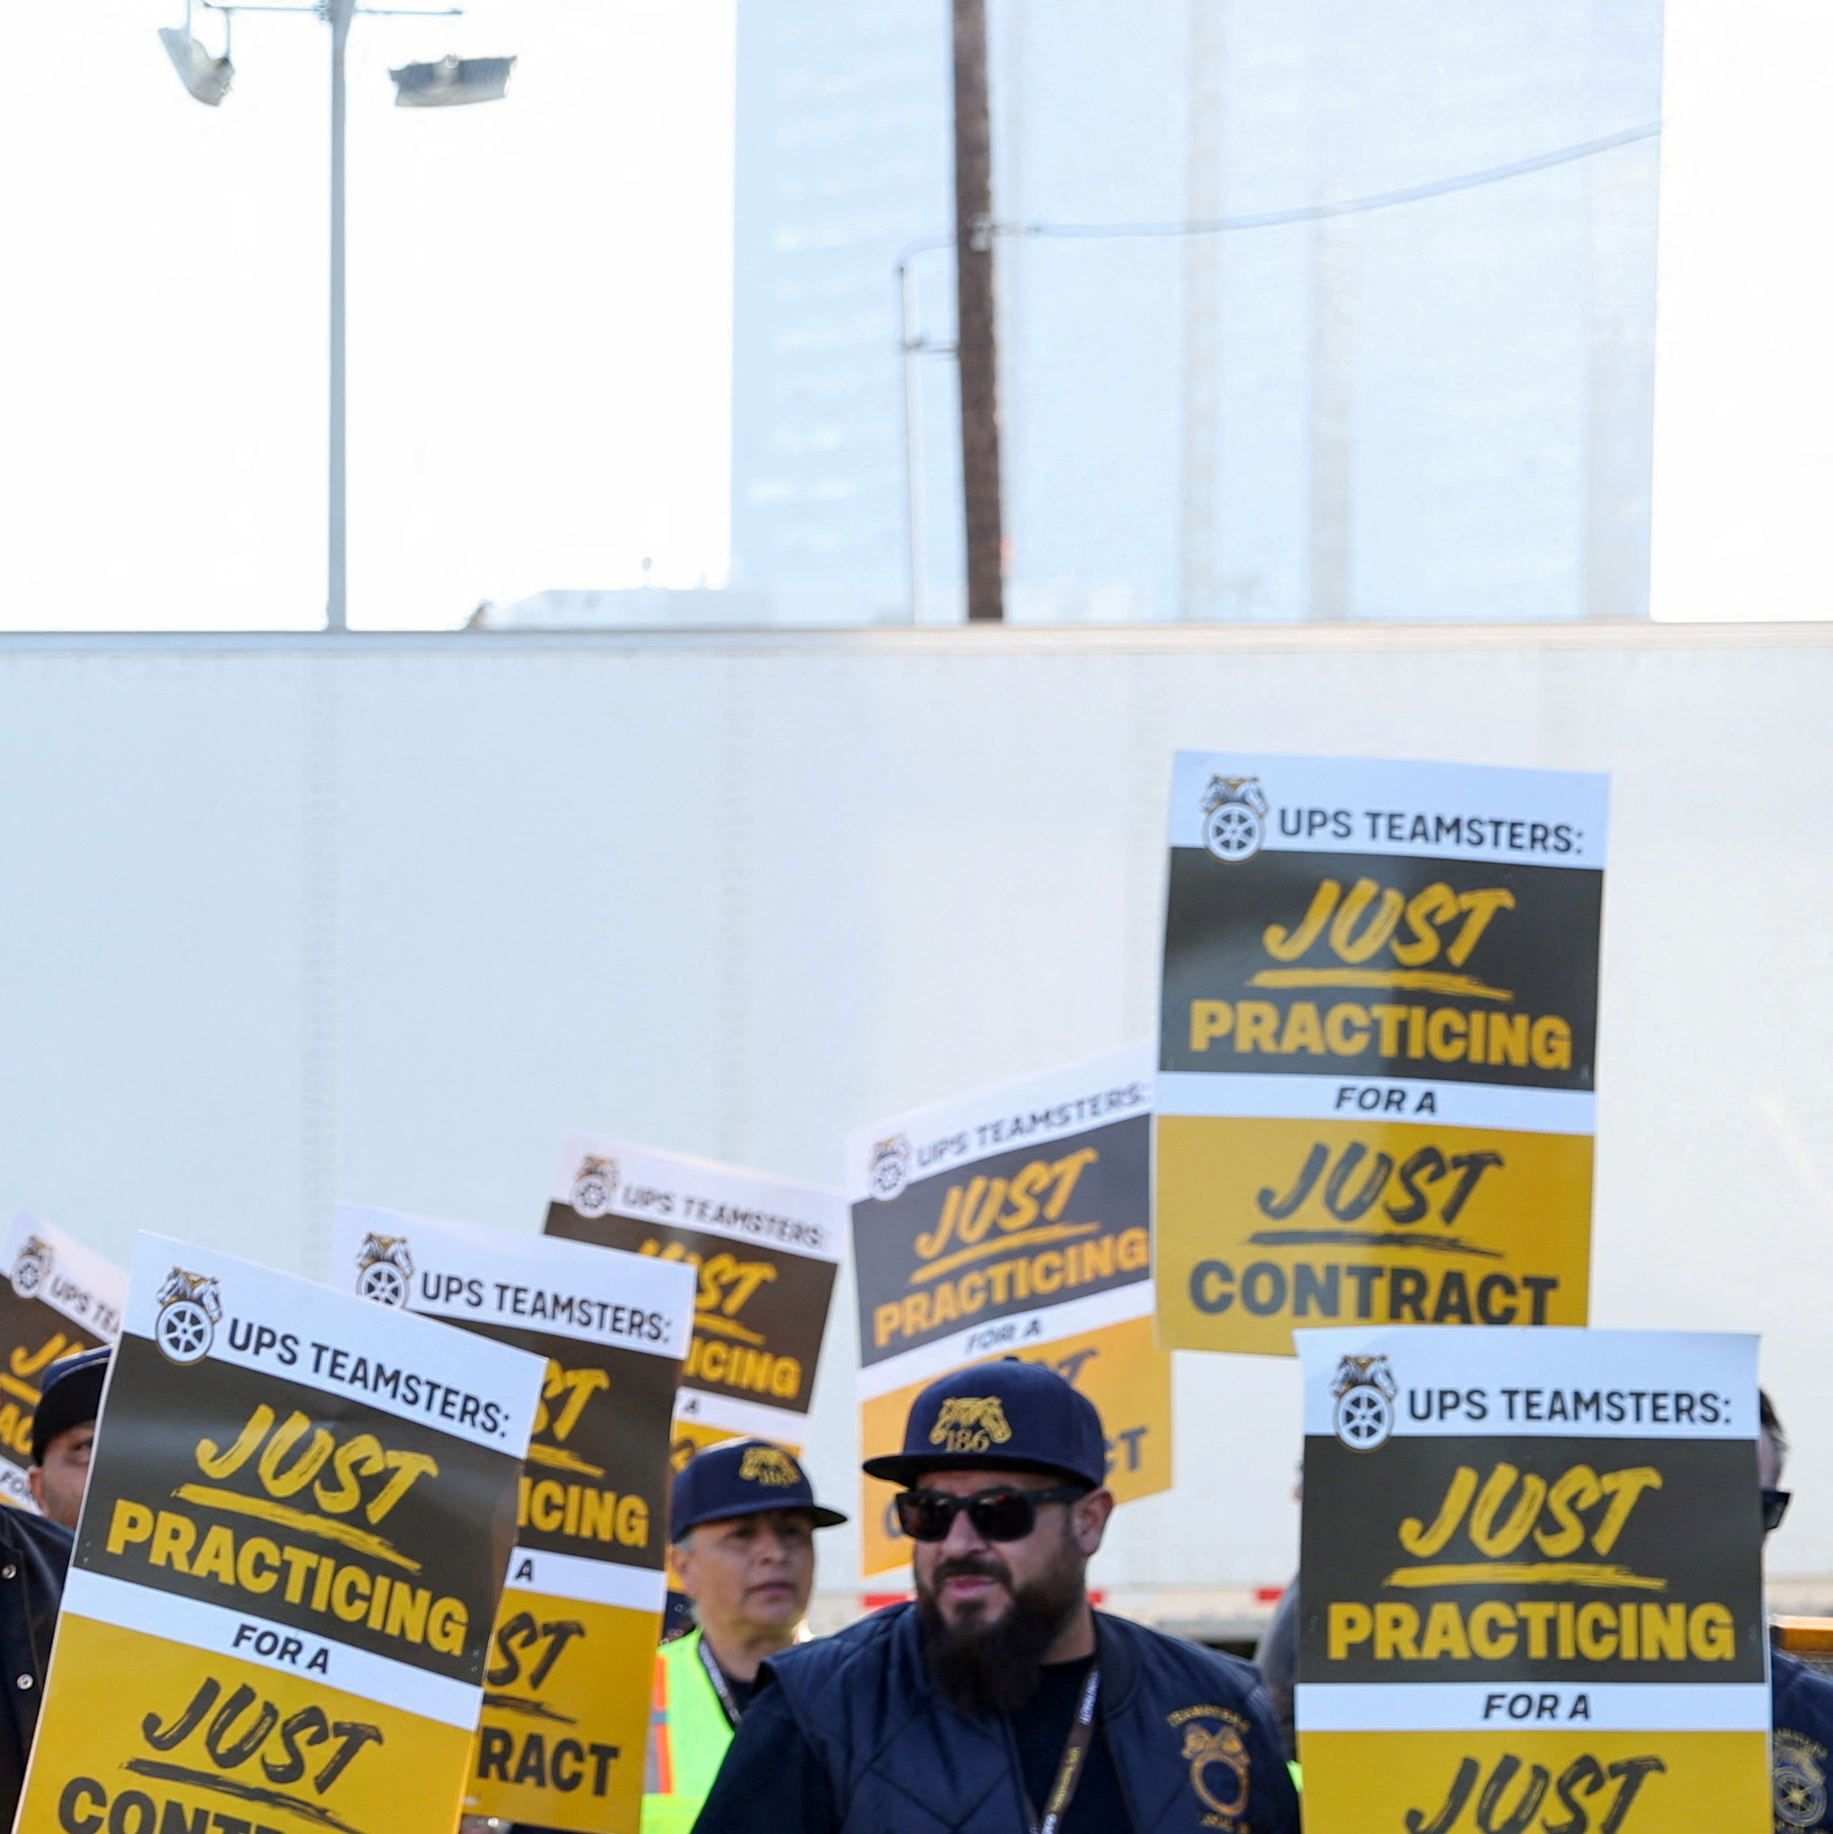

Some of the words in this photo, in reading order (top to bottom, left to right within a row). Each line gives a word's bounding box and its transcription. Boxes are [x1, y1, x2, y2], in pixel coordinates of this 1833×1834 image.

[1279, 807, 1351, 840] UPS
[1365, 810, 1583, 855] TEAMSTERS:
[1263, 878, 1514, 968] JUST
[1190, 1001, 1573, 1070] PRACTICING
[918, 1132, 968, 1170] UPS
[972, 1082, 1145, 1157] TEAMSTERS:
[1335, 1086, 1408, 1112] FOR
[1413, 1088, 1438, 1114] A
[621, 1184, 673, 1214] UPS
[683, 1194, 829, 1249] TEAMSTERS:
[916, 1147, 1098, 1259] JUST
[1259, 1141, 1504, 1226] JUST
[49, 1276, 91, 1316] UPS
[421, 1272, 483, 1309] UPS
[492, 1282, 673, 1345] TEAMSTERS:
[872, 1227, 1150, 1348] PRACTICING
[1189, 1261, 1559, 1327] CONTRACT
[964, 1324, 1018, 1356] FOR
[1019, 1316, 1043, 1340] A
[228, 1318, 298, 1365] UPS
[310, 1343, 510, 1436] TEAMSTERS:
[1409, 1388, 1486, 1420] UPS
[1500, 1390, 1731, 1426] TEAMSTERS:
[195, 1403, 438, 1523] JUST
[945, 1424, 991, 1453] 186
[1399, 1463, 1662, 1558] JUST
[106, 1503, 468, 1656] PRACTICING
[514, 1556, 534, 1582] A
[232, 1623, 303, 1665] FOR
[305, 1644, 330, 1675] A
[1328, 1602, 1735, 1661] PRACTICING
[143, 1676, 383, 1796] JUST
[1484, 1693, 1561, 1720] FOR
[1568, 1694, 1592, 1720] A
